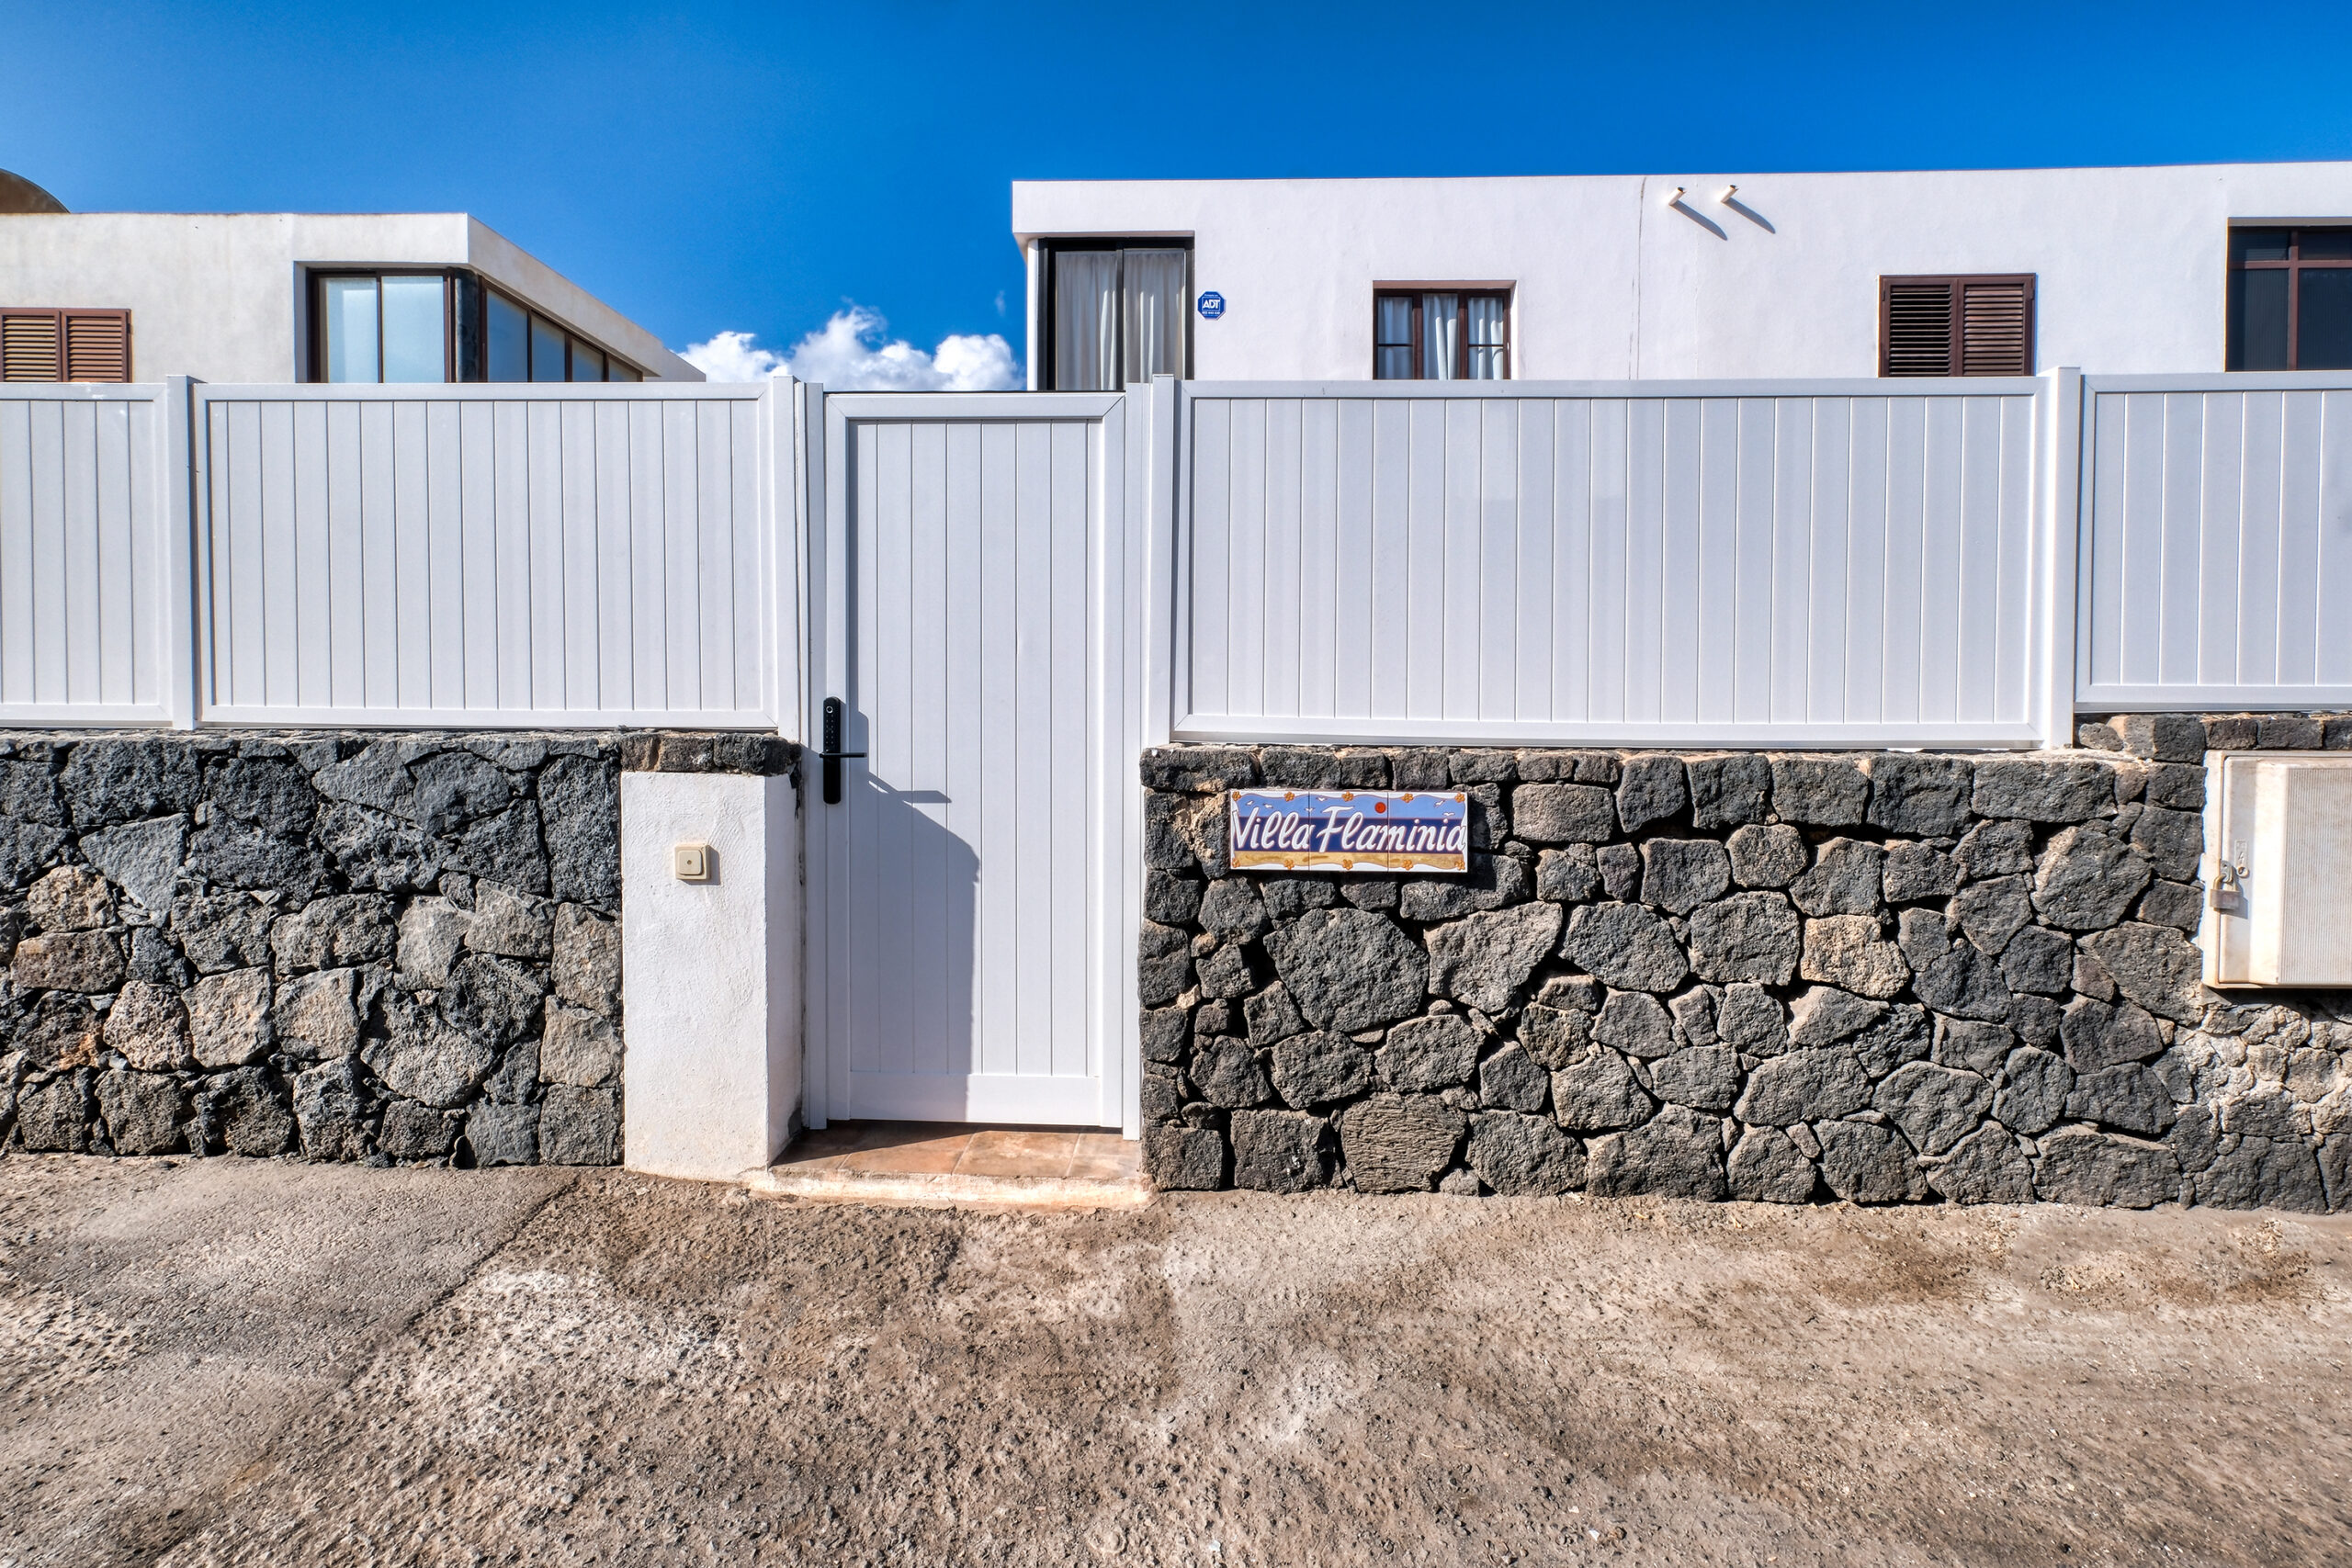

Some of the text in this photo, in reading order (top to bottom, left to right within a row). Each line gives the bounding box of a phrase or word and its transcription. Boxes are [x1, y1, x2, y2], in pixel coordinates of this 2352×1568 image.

[1203, 299, 1221, 309] ADT
[1232, 806, 1466, 853] Villa Flaminia
